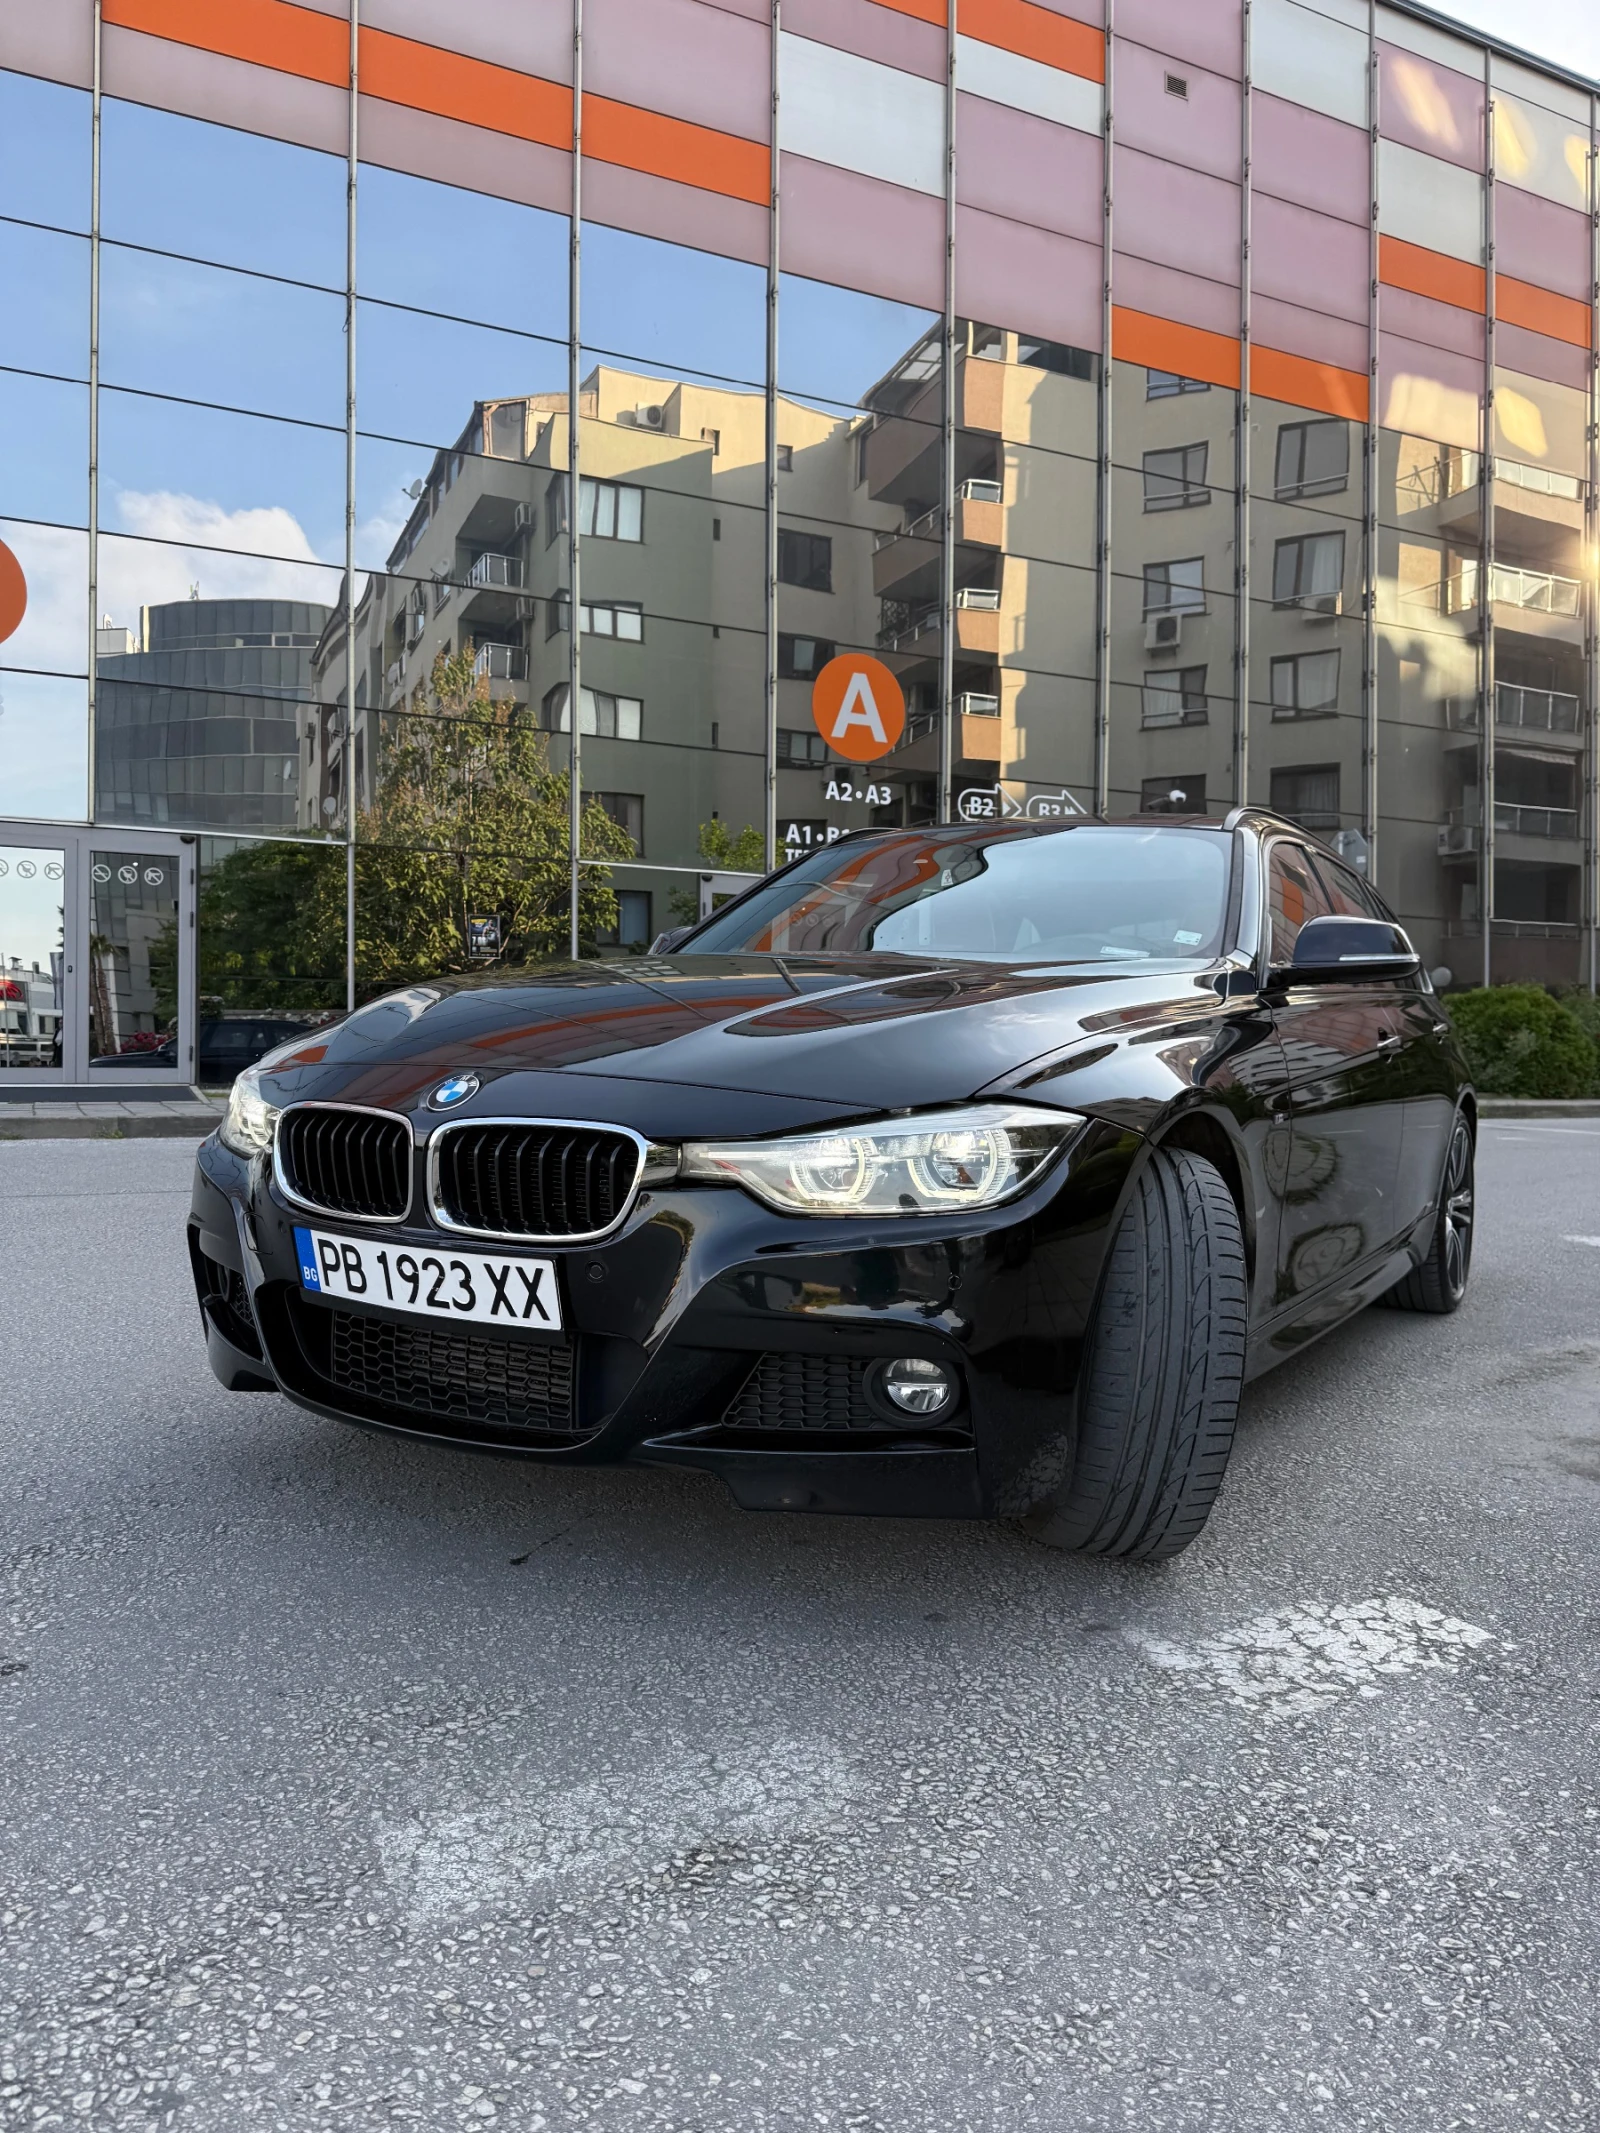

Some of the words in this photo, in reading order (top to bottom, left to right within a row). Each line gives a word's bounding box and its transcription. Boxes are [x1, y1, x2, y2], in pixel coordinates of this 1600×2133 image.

[831, 672, 888, 743] A
[970, 796, 994, 816] B2
[303, 1265, 318, 1282] BG
[317, 1238, 367, 1294] PB
[376, 1250, 477, 1312] 1923
[483, 1263, 550, 1321] XX
